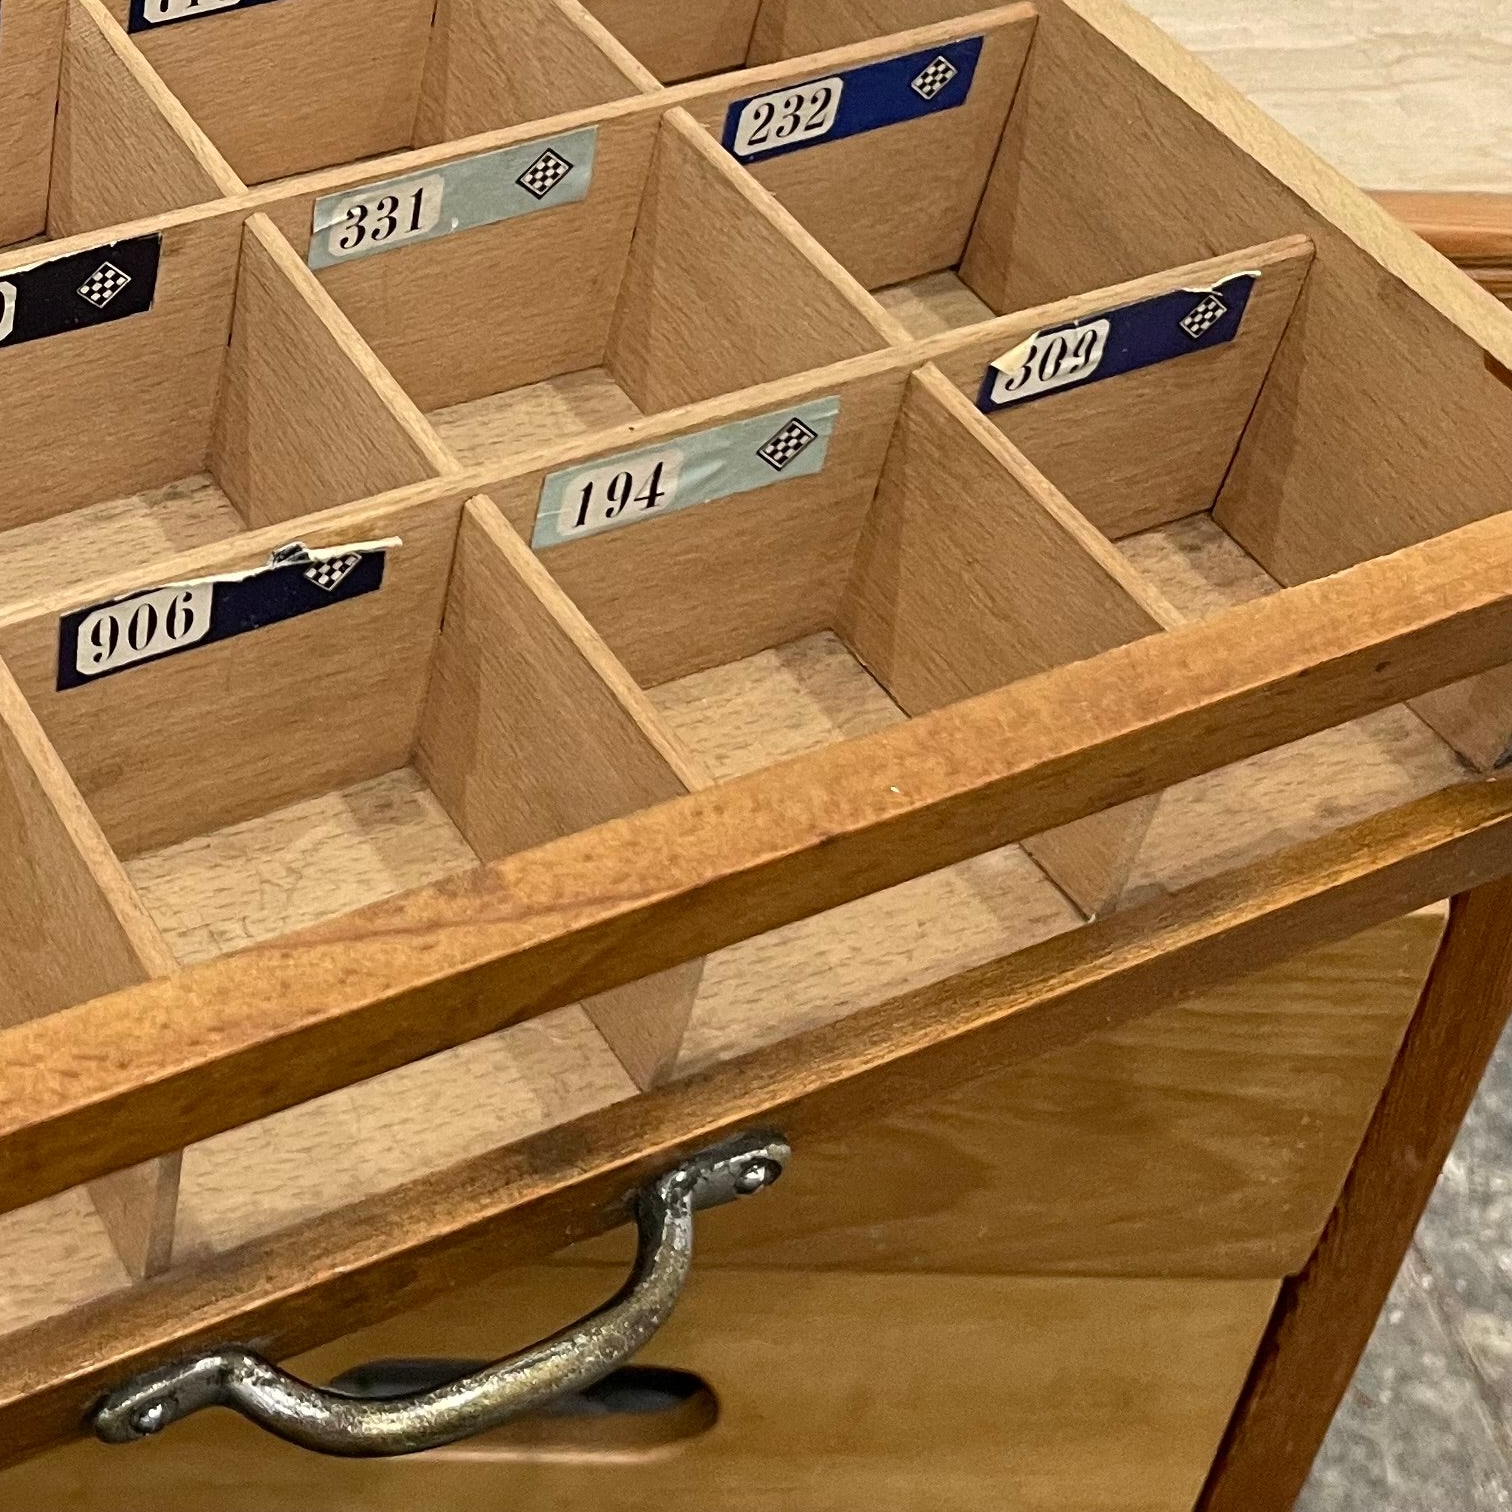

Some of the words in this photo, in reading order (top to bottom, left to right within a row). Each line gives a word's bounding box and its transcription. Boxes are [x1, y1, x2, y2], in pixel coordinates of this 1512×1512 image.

[747, 87, 832, 146] 232
[339, 187, 424, 250] 331
[575, 461, 665, 528] 194
[90, 591, 194, 663] 906
